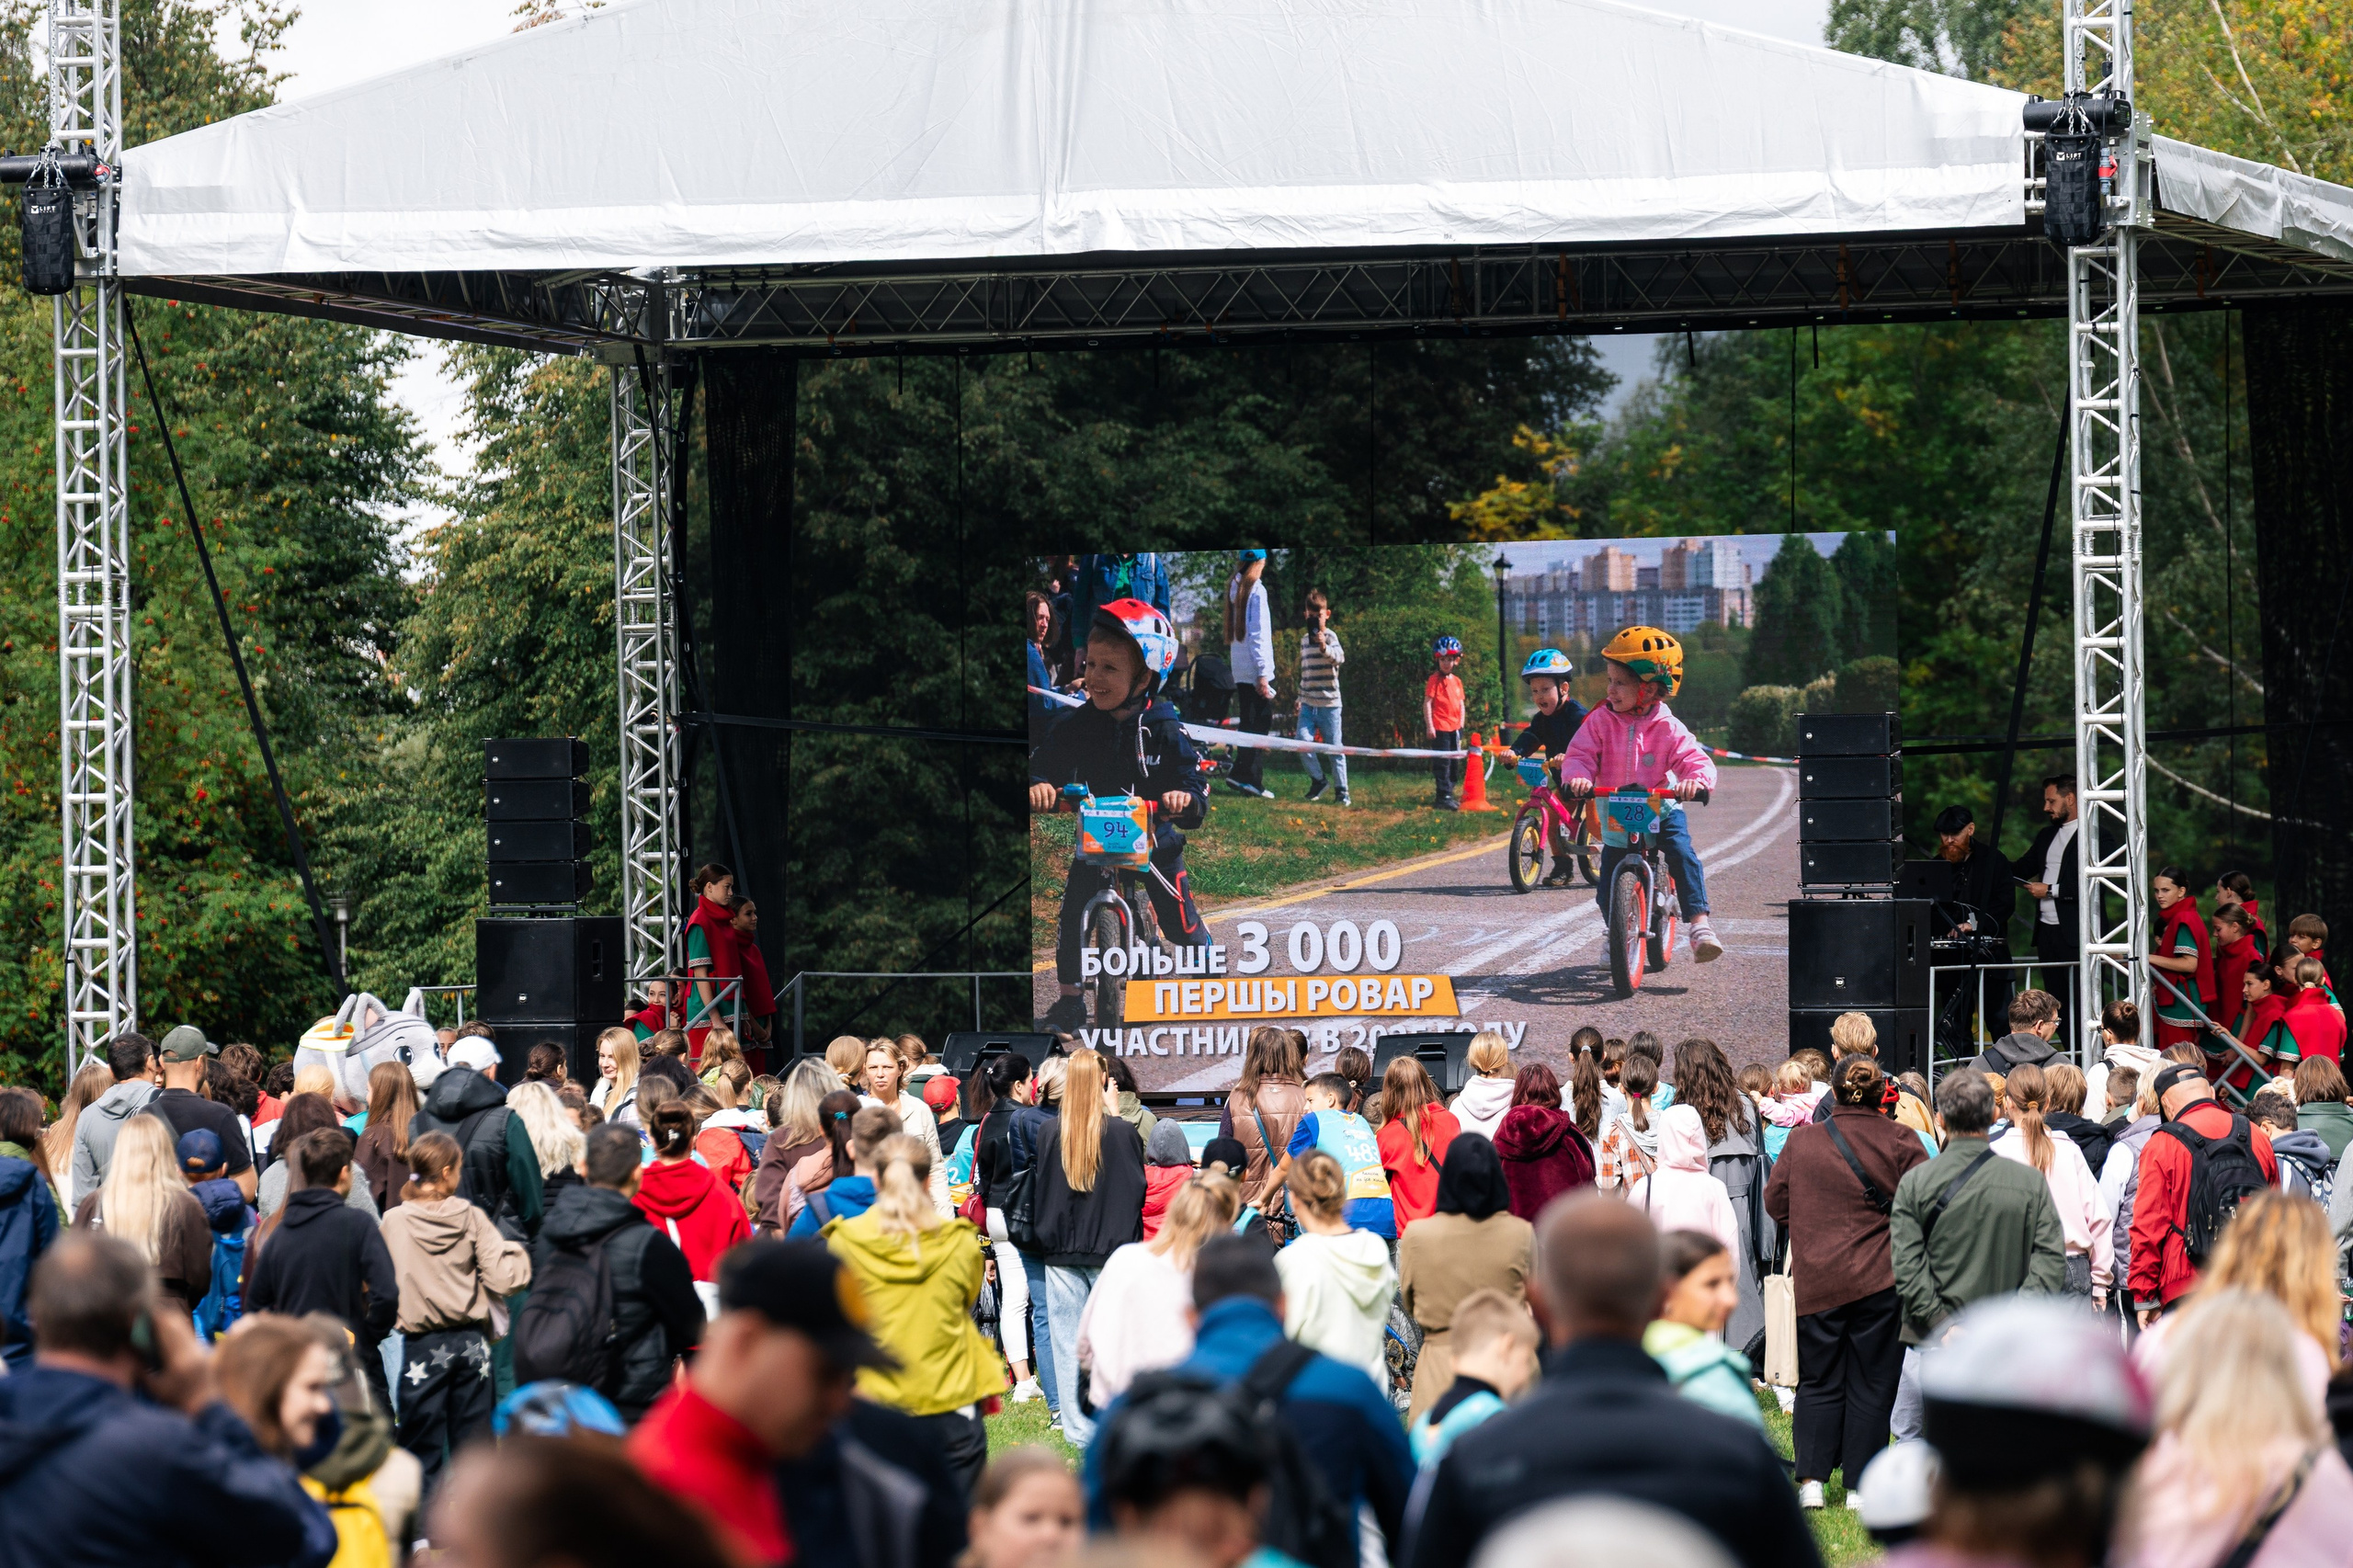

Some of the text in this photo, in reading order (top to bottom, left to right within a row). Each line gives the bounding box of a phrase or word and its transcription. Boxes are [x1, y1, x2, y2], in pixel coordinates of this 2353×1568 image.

[1104, 821, 1128, 838] 94
[1624, 805, 1644, 822] 28
[1081, 919, 1402, 976] БОЛЬШЕ 3 000
[1155, 978, 1433, 1014] ПЕРШЫ РОВАР
[1079, 1025, 1312, 1056] УЧАСТНИ
[1321, 1023, 1341, 1053] В
